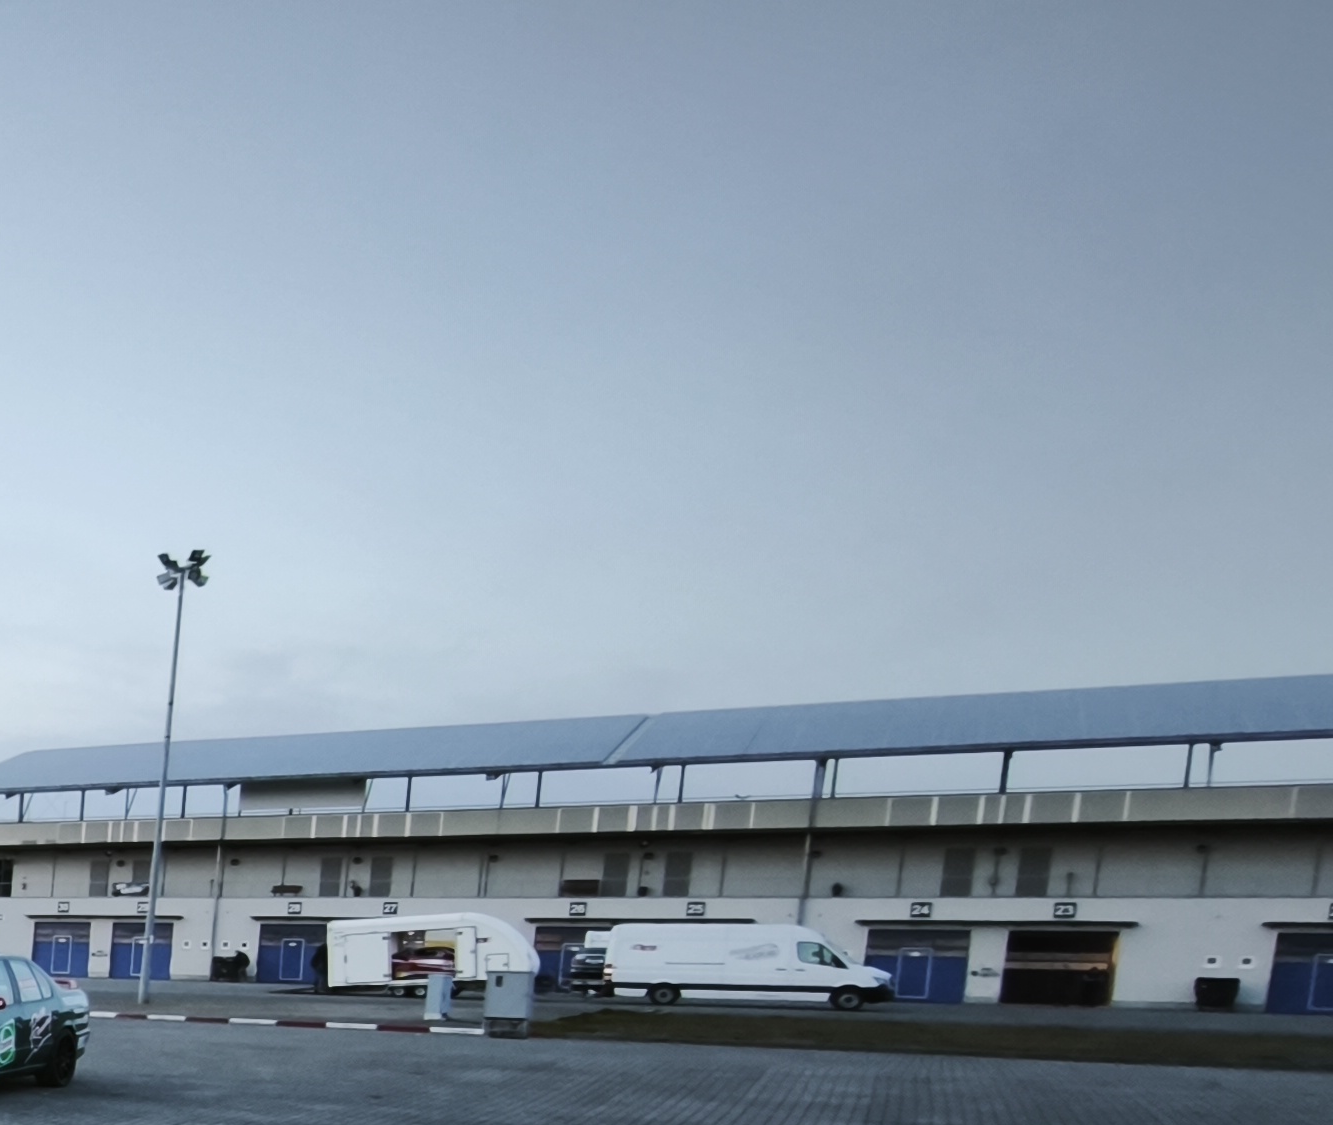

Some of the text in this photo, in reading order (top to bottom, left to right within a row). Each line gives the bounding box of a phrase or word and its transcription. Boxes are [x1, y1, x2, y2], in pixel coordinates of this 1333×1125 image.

[383, 904, 397, 913] 27
[687, 904, 704, 914] 25
[911, 905, 930, 915] 24
[1054, 905, 1074, 915] 23
